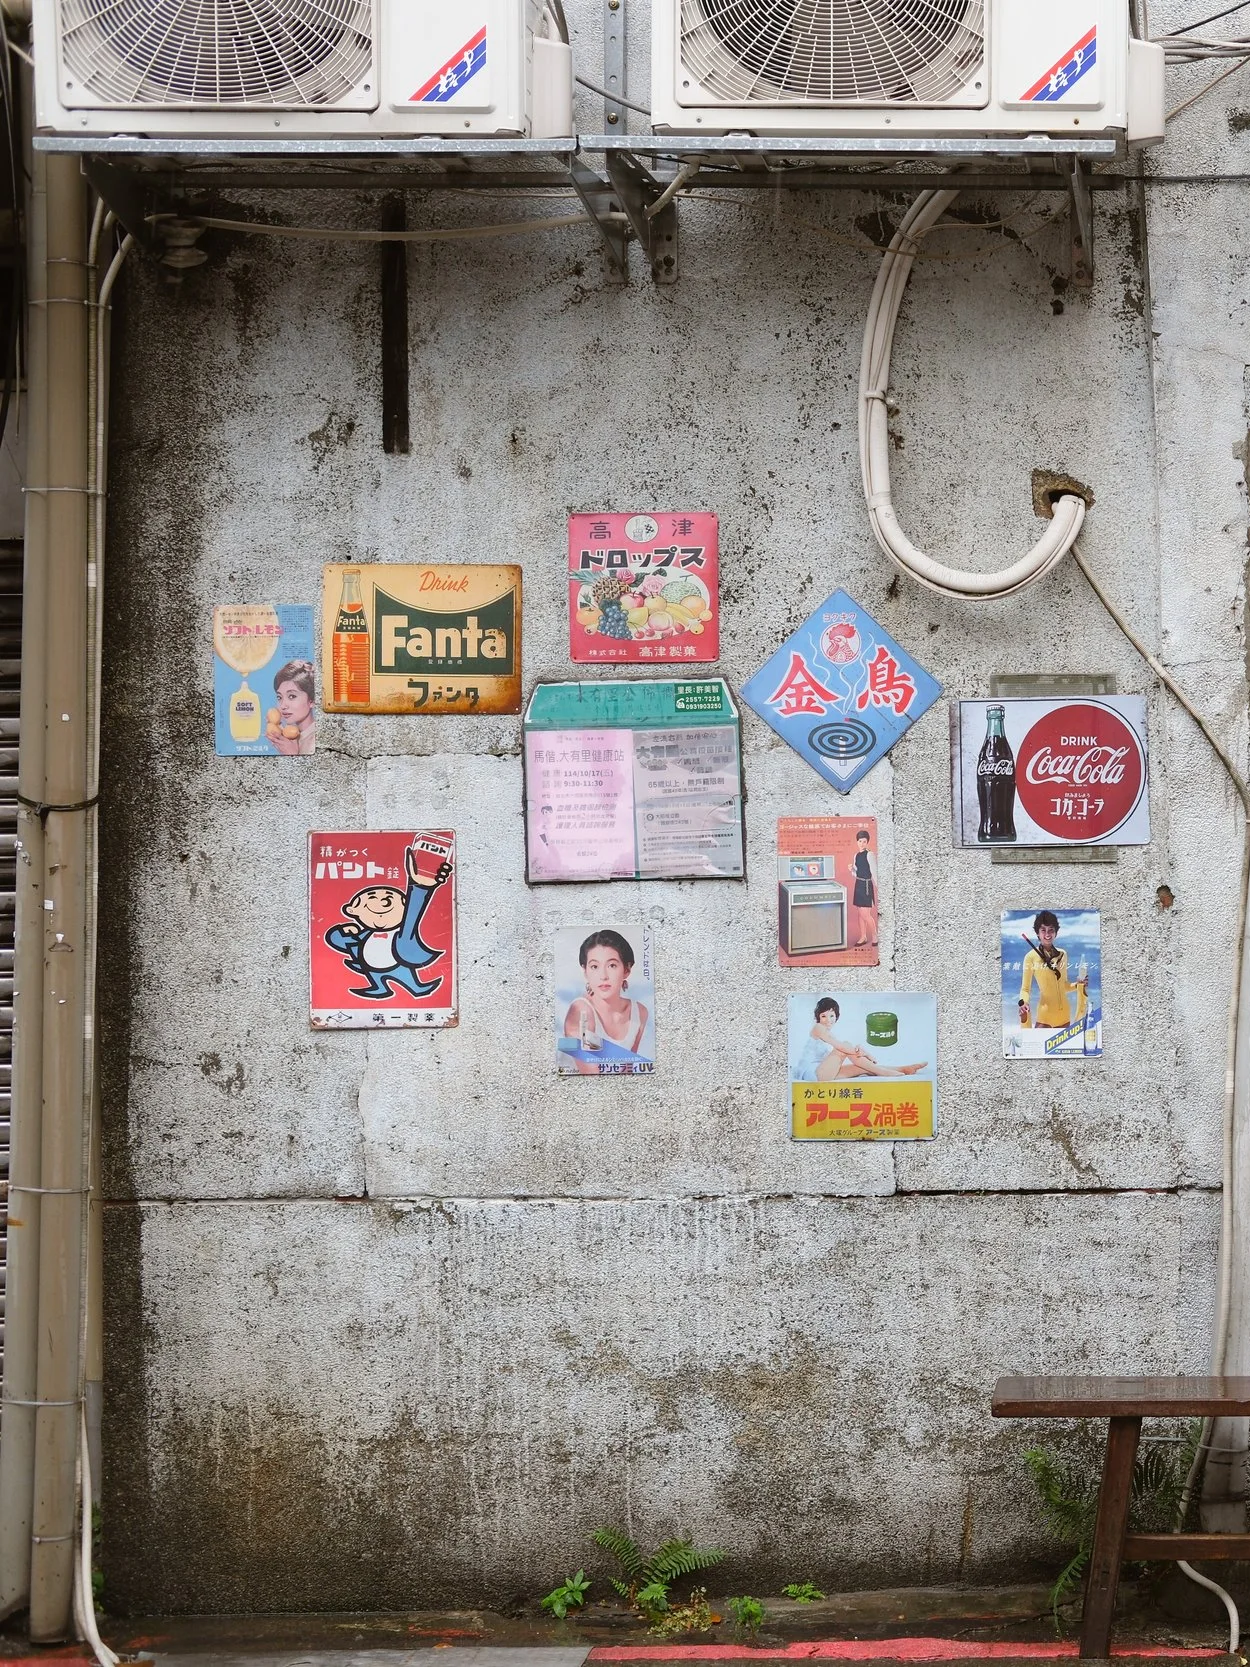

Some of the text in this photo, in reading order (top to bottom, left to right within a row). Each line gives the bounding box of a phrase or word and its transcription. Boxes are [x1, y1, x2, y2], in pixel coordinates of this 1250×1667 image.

[580, 546, 706, 570] ドロップス
[419, 570, 470, 593] Drink
[338, 615, 366, 627] Fanta
[382, 615, 508, 667] Fanta
[638, 646, 697, 657] 高津製菓
[764, 644, 917, 718] 金鳥
[407, 678, 480, 708] ファンタ
[1060, 736, 1097, 746] DRINK
[977, 759, 1013, 776] Coca-Cola
[1026, 746, 1130, 784] Coca-Cola
[419, 841, 447, 854] パント
[1046, 1030, 1069, 1050] Drink
[1069, 1020, 1084, 1035] up!
[804, 1088, 864, 1099] かとり線香
[806, 1102, 919, 1128] アース渦巻
